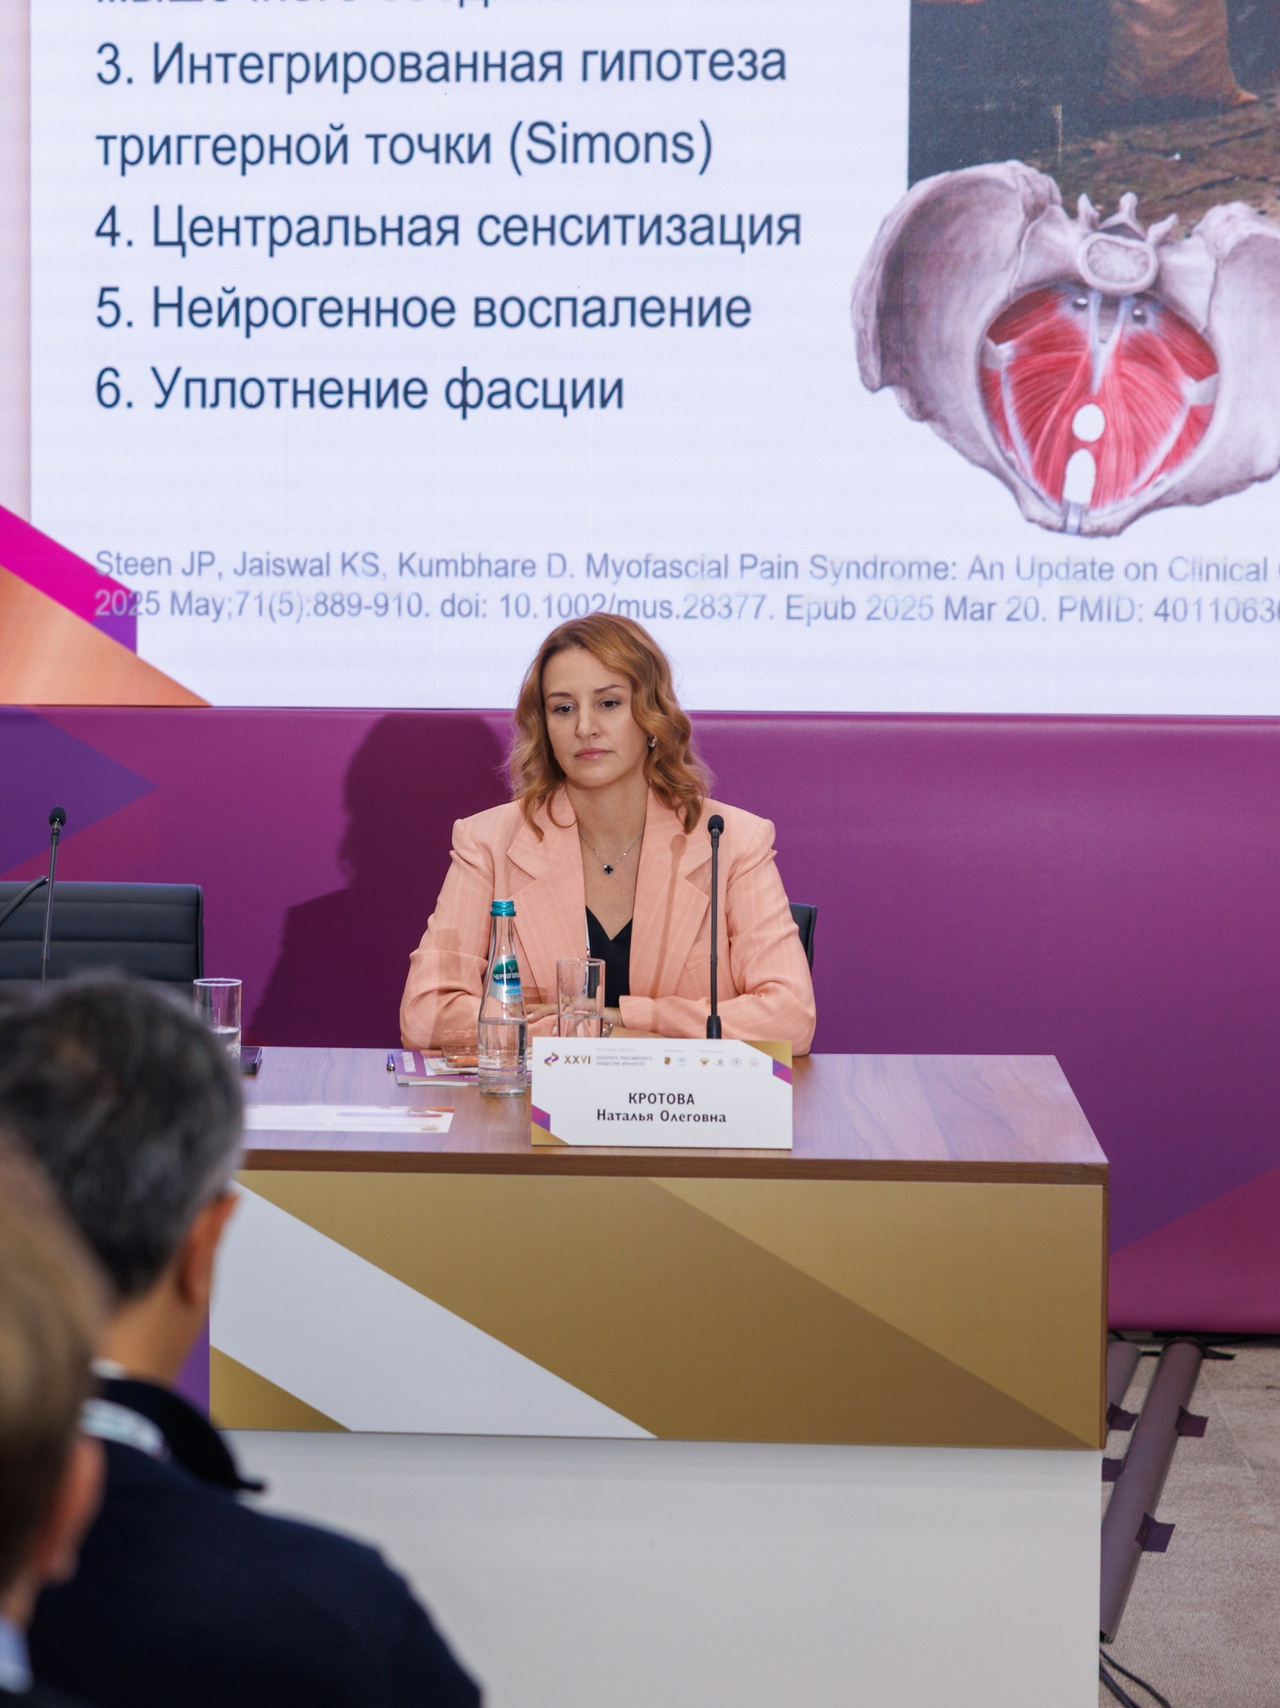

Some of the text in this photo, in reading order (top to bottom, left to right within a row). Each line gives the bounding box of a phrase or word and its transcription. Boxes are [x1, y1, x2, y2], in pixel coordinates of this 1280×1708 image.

[96, 42, 786, 94] 3. Интегрированная гипотеза
[95, 119, 712, 177] триггерной точки (Simons)
[94, 205, 801, 258] 4. Центральная сенситизация
[96, 286, 752, 338] 5. Нейрогенное воспаление
[95, 365, 624, 420] 6. Уплотнение фасции
[94, 550, 171, 577] Steen
[181, 551, 223, 581] JP,
[233, 551, 331, 578] Jaiswal
[340, 551, 388, 582] KS,
[398, 552, 537, 579] Kumbhare
[547, 553, 575, 579] D.
[586, 552, 729, 585] Myofascial
[739, 553, 799, 580] Pain
[809, 554, 957, 586] Syndrome:
[967, 555, 1005, 581] An
[1015, 555, 1115, 587] Update
[1123, 562, 1158, 582] on
[1167, 556, 1268, 582] Clinical
[93, 590, 161, 617] 2025
[440, 592, 487, 619] doi:
[500, 593, 774, 621] 10.1002/mus.28377.
[785, 595, 857, 627] Epub
[865, 595, 934, 622] 2025
[944, 596, 997, 622] Mar
[1005, 596, 1048, 623] 20.
[1058, 596, 1144, 623] PMID:
[1153, 596, 1280, 623] 4011063
[564, 1055, 591, 1065] XXVI
[596, 1108, 727, 1124] Наталья Олеговна
[628, 1092, 695, 1105] КРОТОВА
